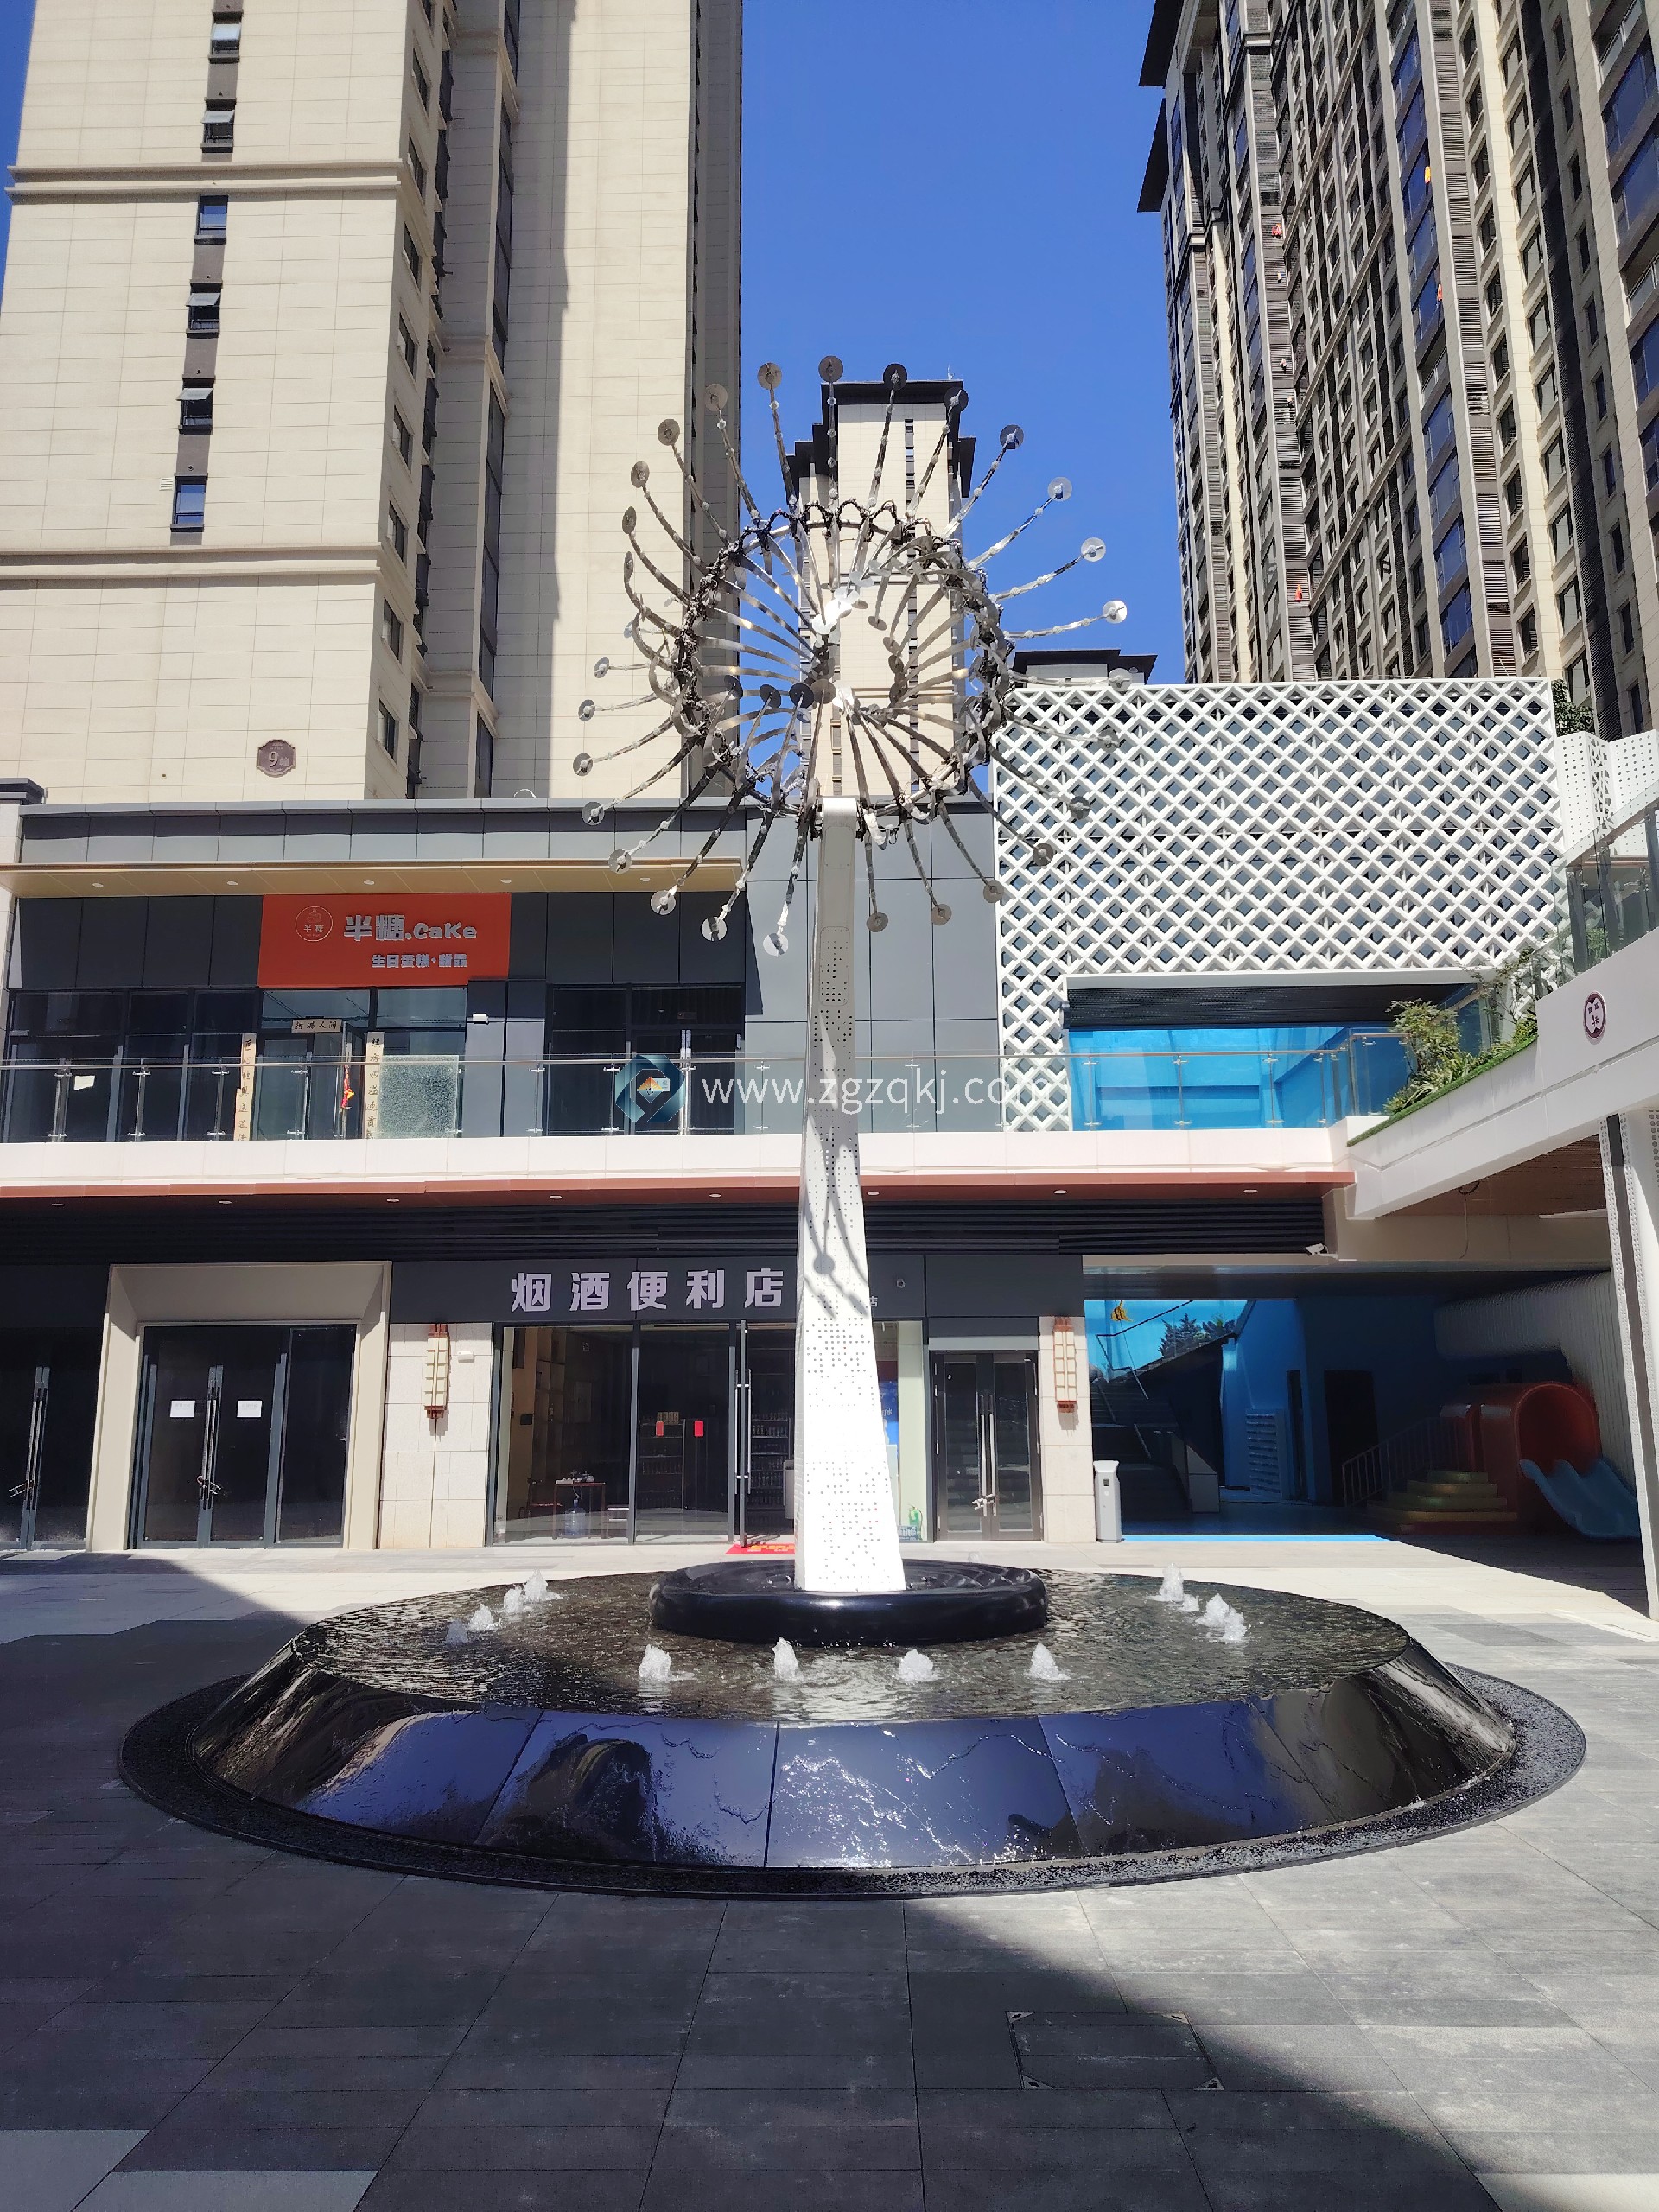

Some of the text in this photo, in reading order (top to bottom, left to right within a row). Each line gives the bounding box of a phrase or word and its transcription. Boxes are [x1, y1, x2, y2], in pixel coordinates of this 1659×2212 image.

[511, 1268, 785, 1313] 烟酒便利店
